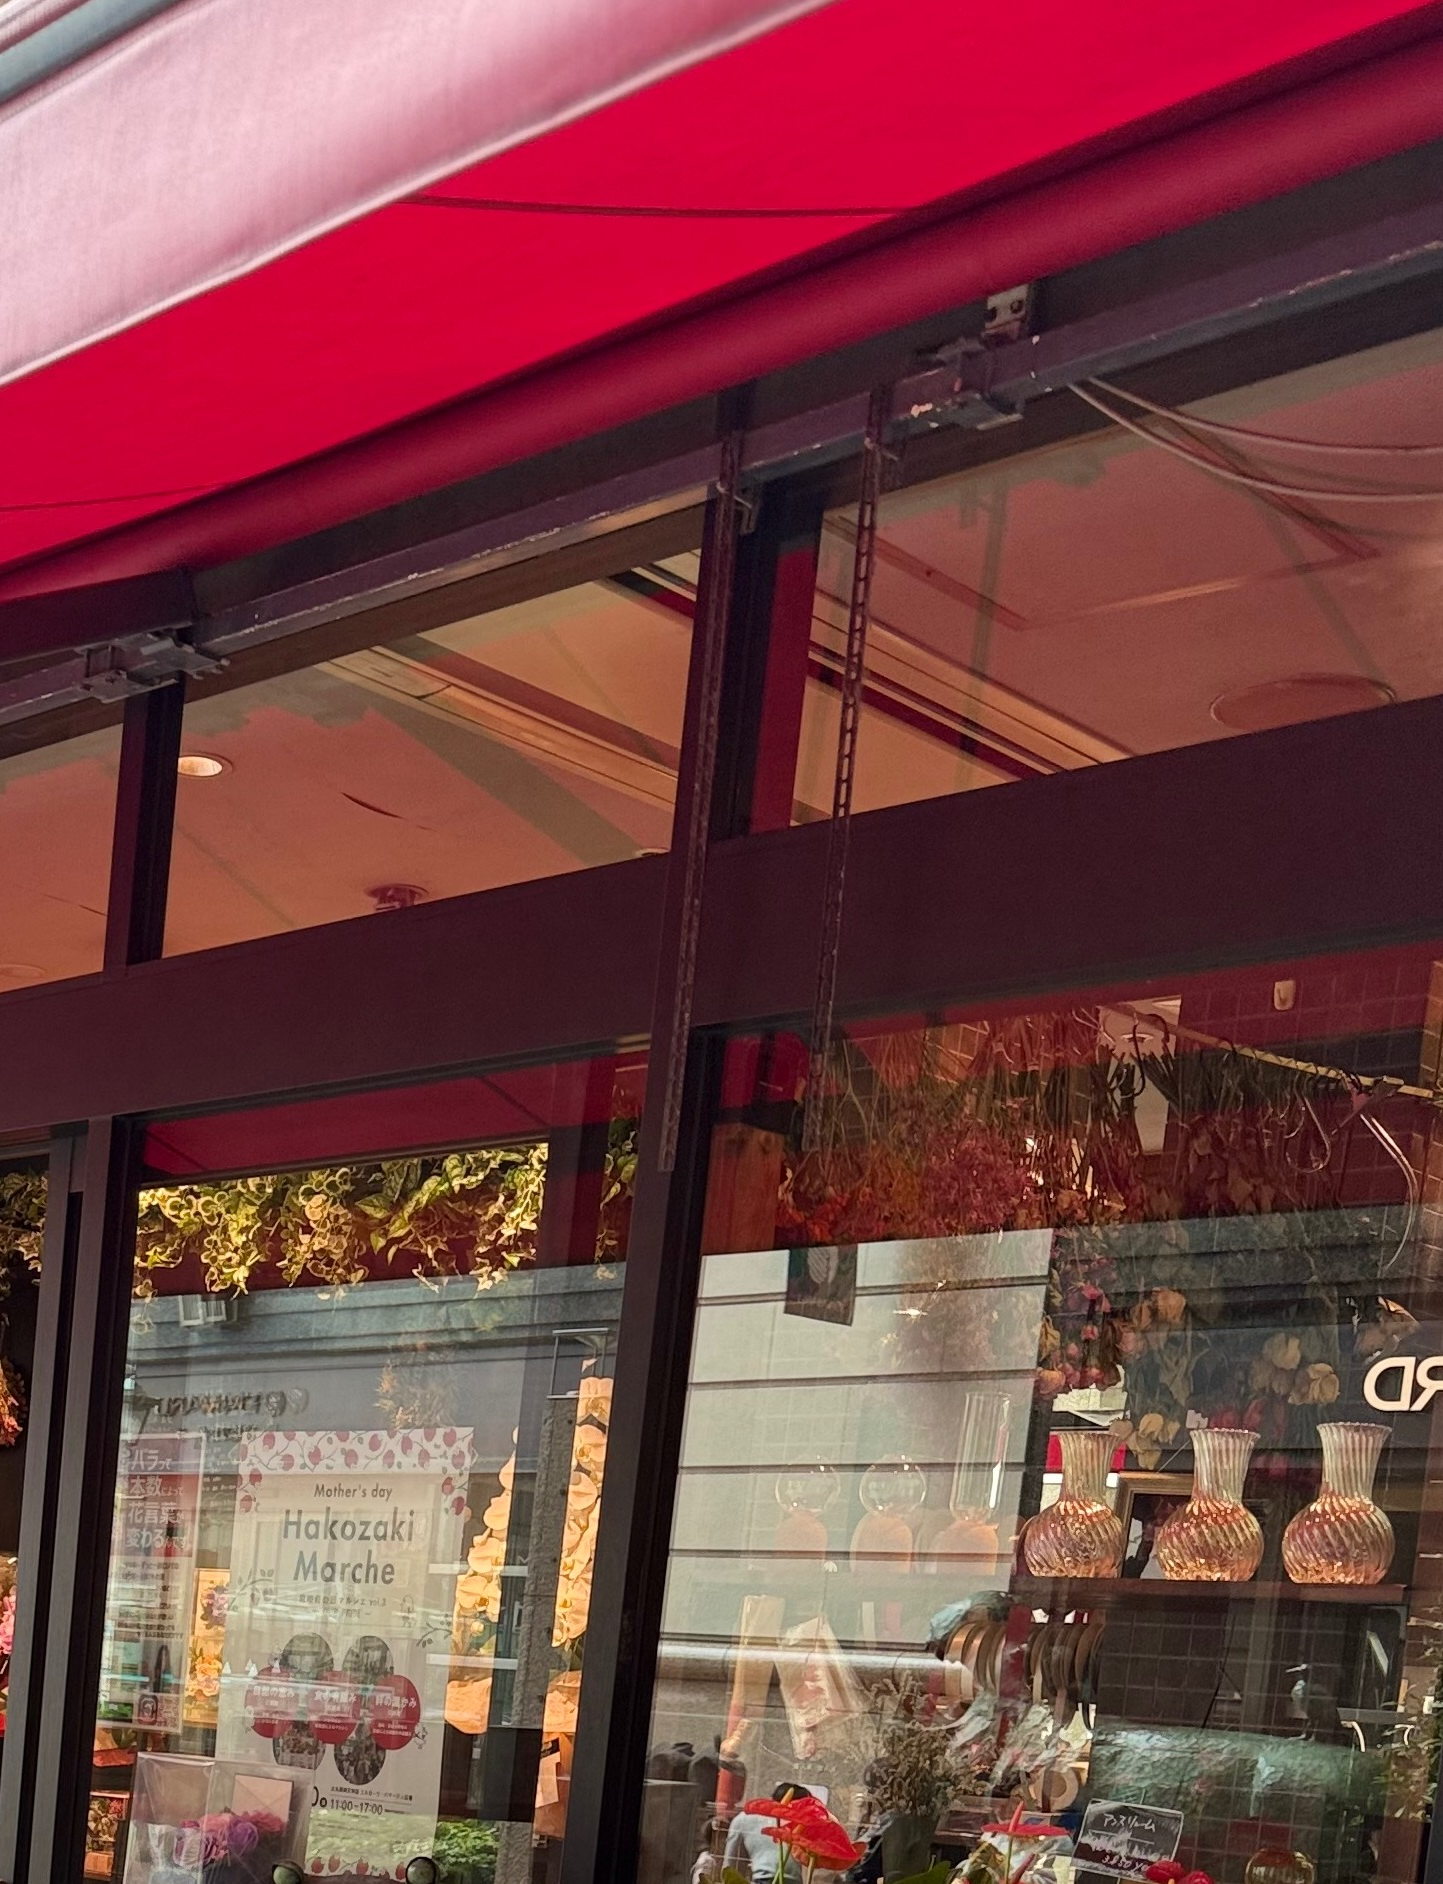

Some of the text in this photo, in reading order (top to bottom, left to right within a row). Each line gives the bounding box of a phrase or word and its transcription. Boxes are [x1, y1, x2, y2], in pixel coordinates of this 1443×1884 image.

[314, 1482, 393, 1501] Mother's day
[282, 1506, 415, 1543] Hakozaki
[293, 1549, 396, 1585] Marche
